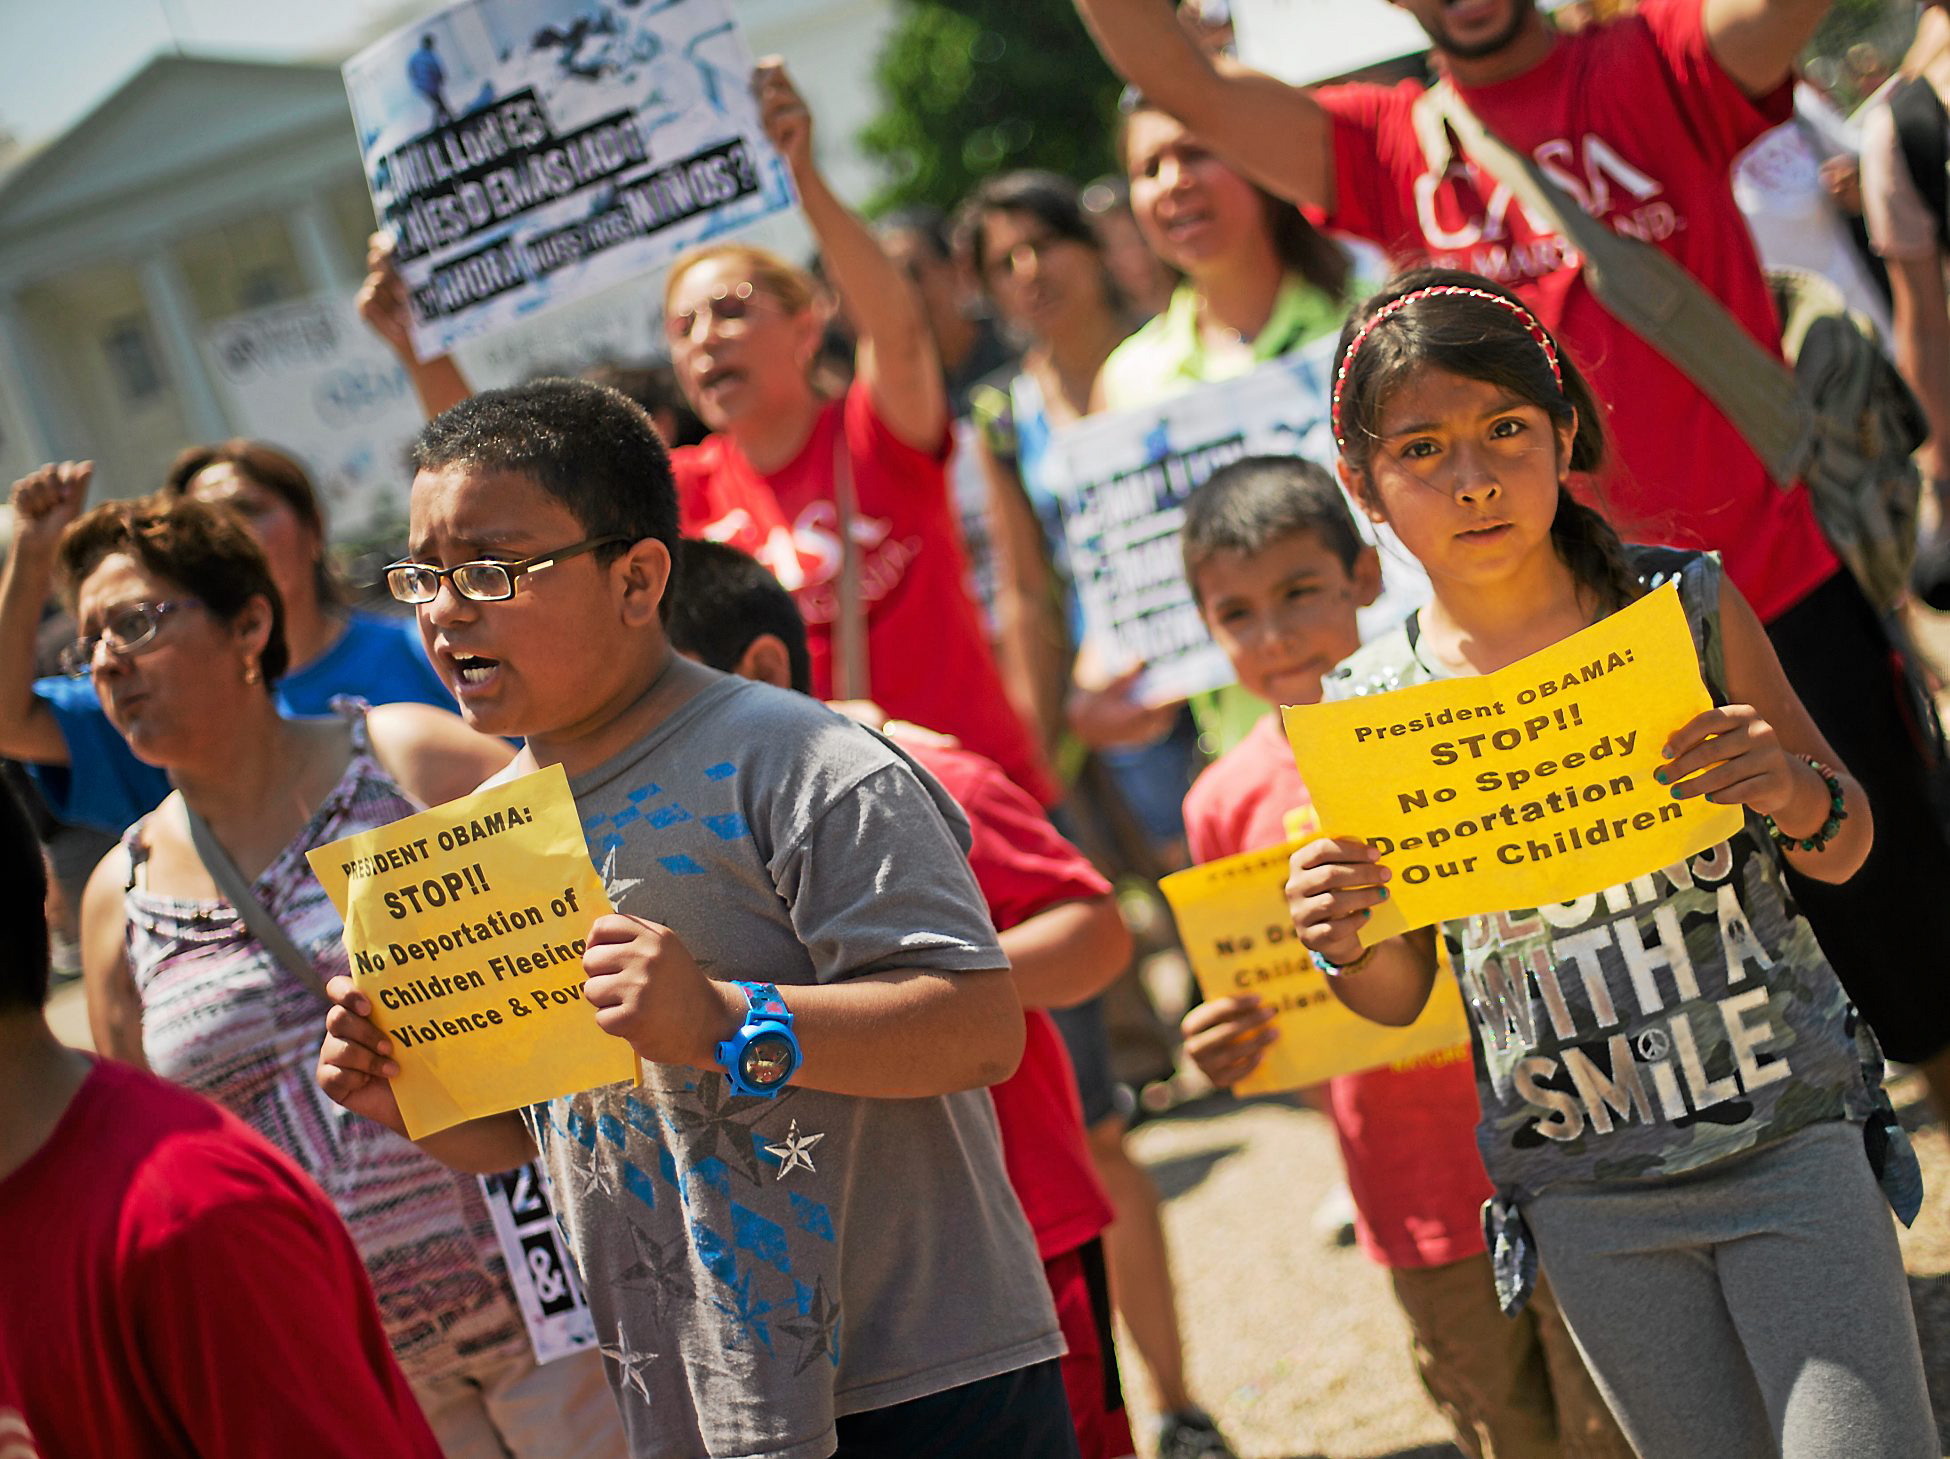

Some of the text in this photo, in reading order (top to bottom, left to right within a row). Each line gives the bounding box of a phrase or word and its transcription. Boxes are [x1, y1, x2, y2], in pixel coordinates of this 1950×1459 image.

[1355, 649, 1634, 742] President OBAMA:
[1431, 703, 1583, 765] STOP!!
[1398, 730, 1637, 813] No Speedy
[342, 806, 533, 880] PRESIDENT OBAMA:
[1366, 775, 1634, 856] Deportation
[1402, 803, 1683, 884] Our Children
[355, 887, 579, 975] No Deportation of
[384, 864, 490, 919] STOP!!
[379, 938, 586, 1010] Children Fleeing
[1462, 904, 1700, 1050] WITH
[1717, 883, 1775, 985] A
[390, 1010, 503, 1048] Violence
[511, 997, 532, 1017] &
